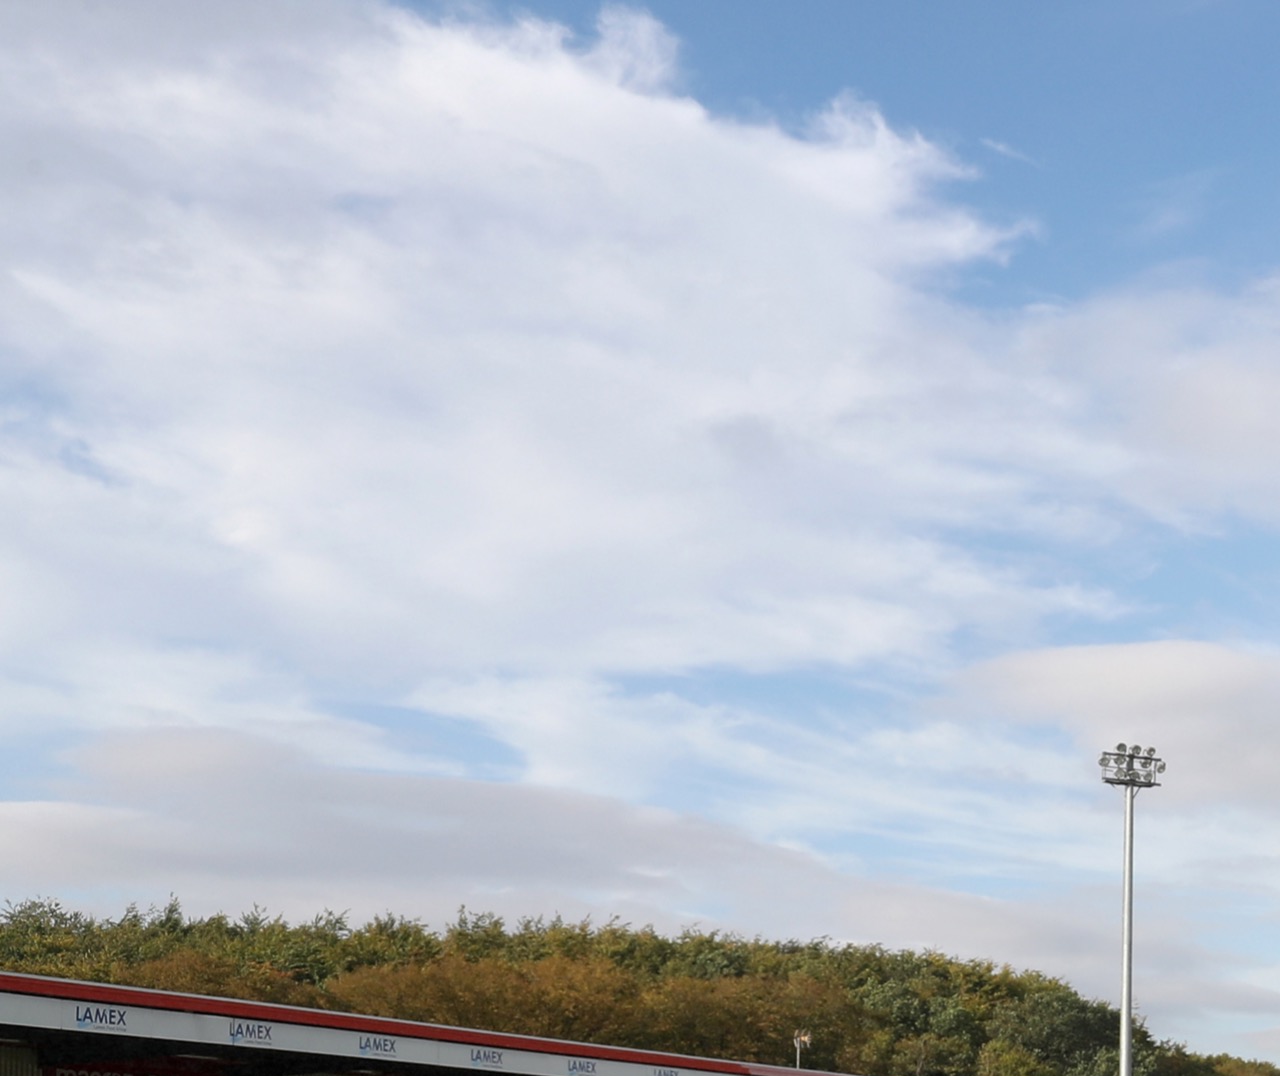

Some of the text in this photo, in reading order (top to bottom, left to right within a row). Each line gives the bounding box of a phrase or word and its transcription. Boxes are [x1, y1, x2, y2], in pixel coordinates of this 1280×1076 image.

[76, 1006, 127, 1026] LAMEX
[229, 1021, 273, 1040] LAMEX
[359, 1036, 396, 1053] LAMEX
[471, 1049, 503, 1065] LAMEX
[568, 1060, 597, 1073] LAMEX
